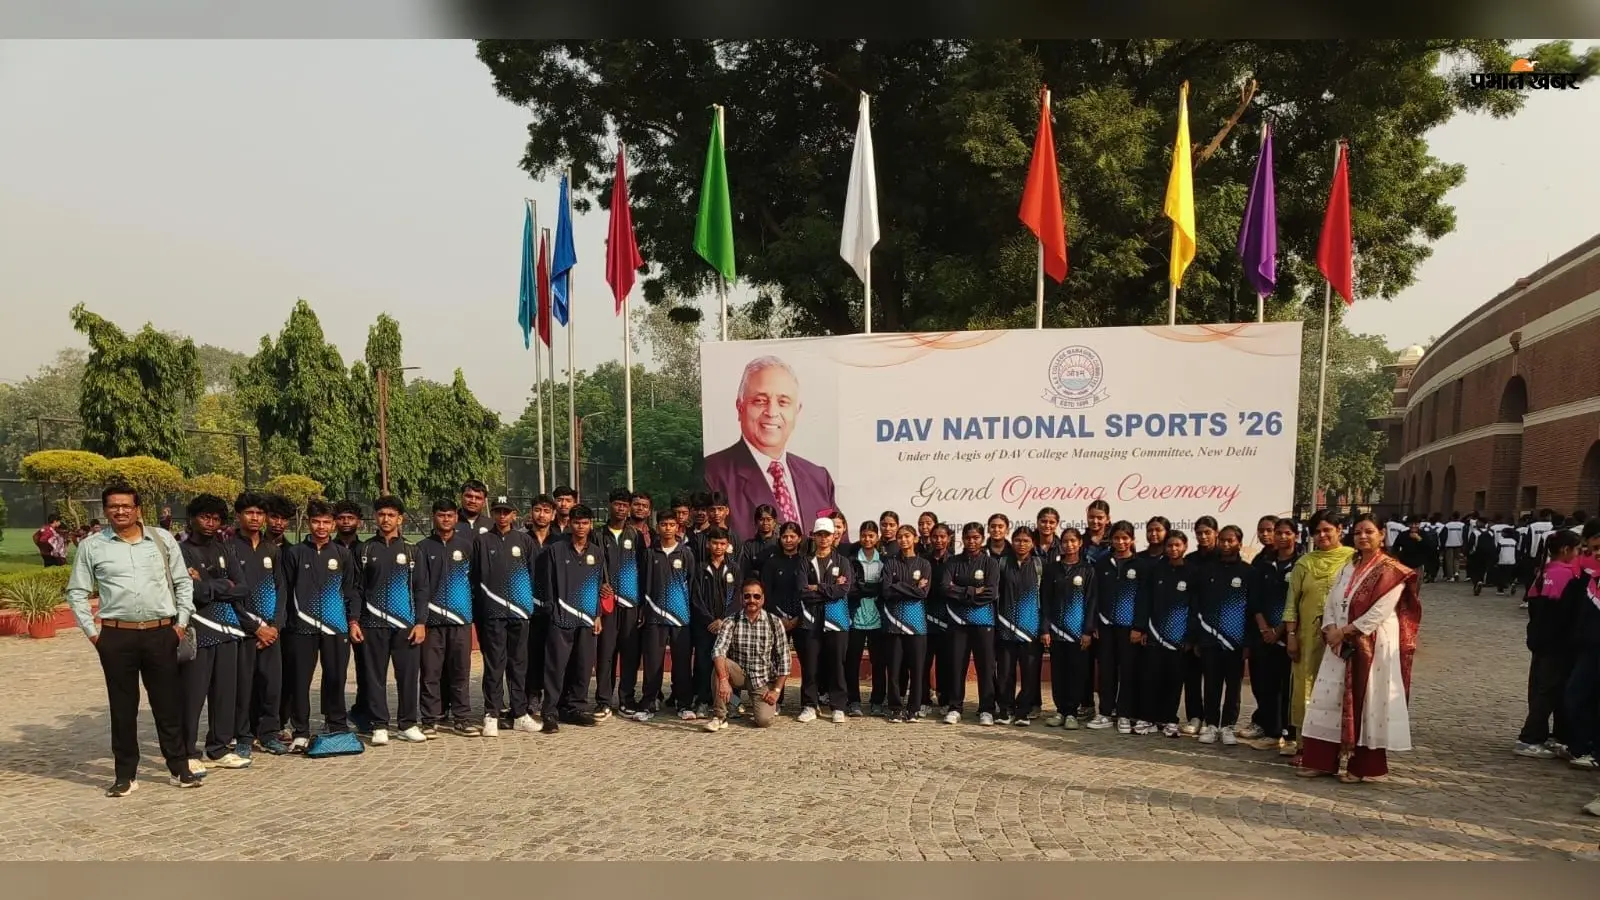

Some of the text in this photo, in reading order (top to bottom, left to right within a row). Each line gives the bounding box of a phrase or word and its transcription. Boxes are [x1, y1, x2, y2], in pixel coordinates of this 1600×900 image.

[876, 417, 933, 443] DAV
[943, 414, 1094, 441] NATIONAL
[1105, 412, 1228, 438] SPORTS
[897, 446, 1258, 463] Under the Aegis of DAV College Managing Committee, New Delhi
[911, 475, 996, 508] Grand
[1117, 472, 1240, 513] Ceremony
